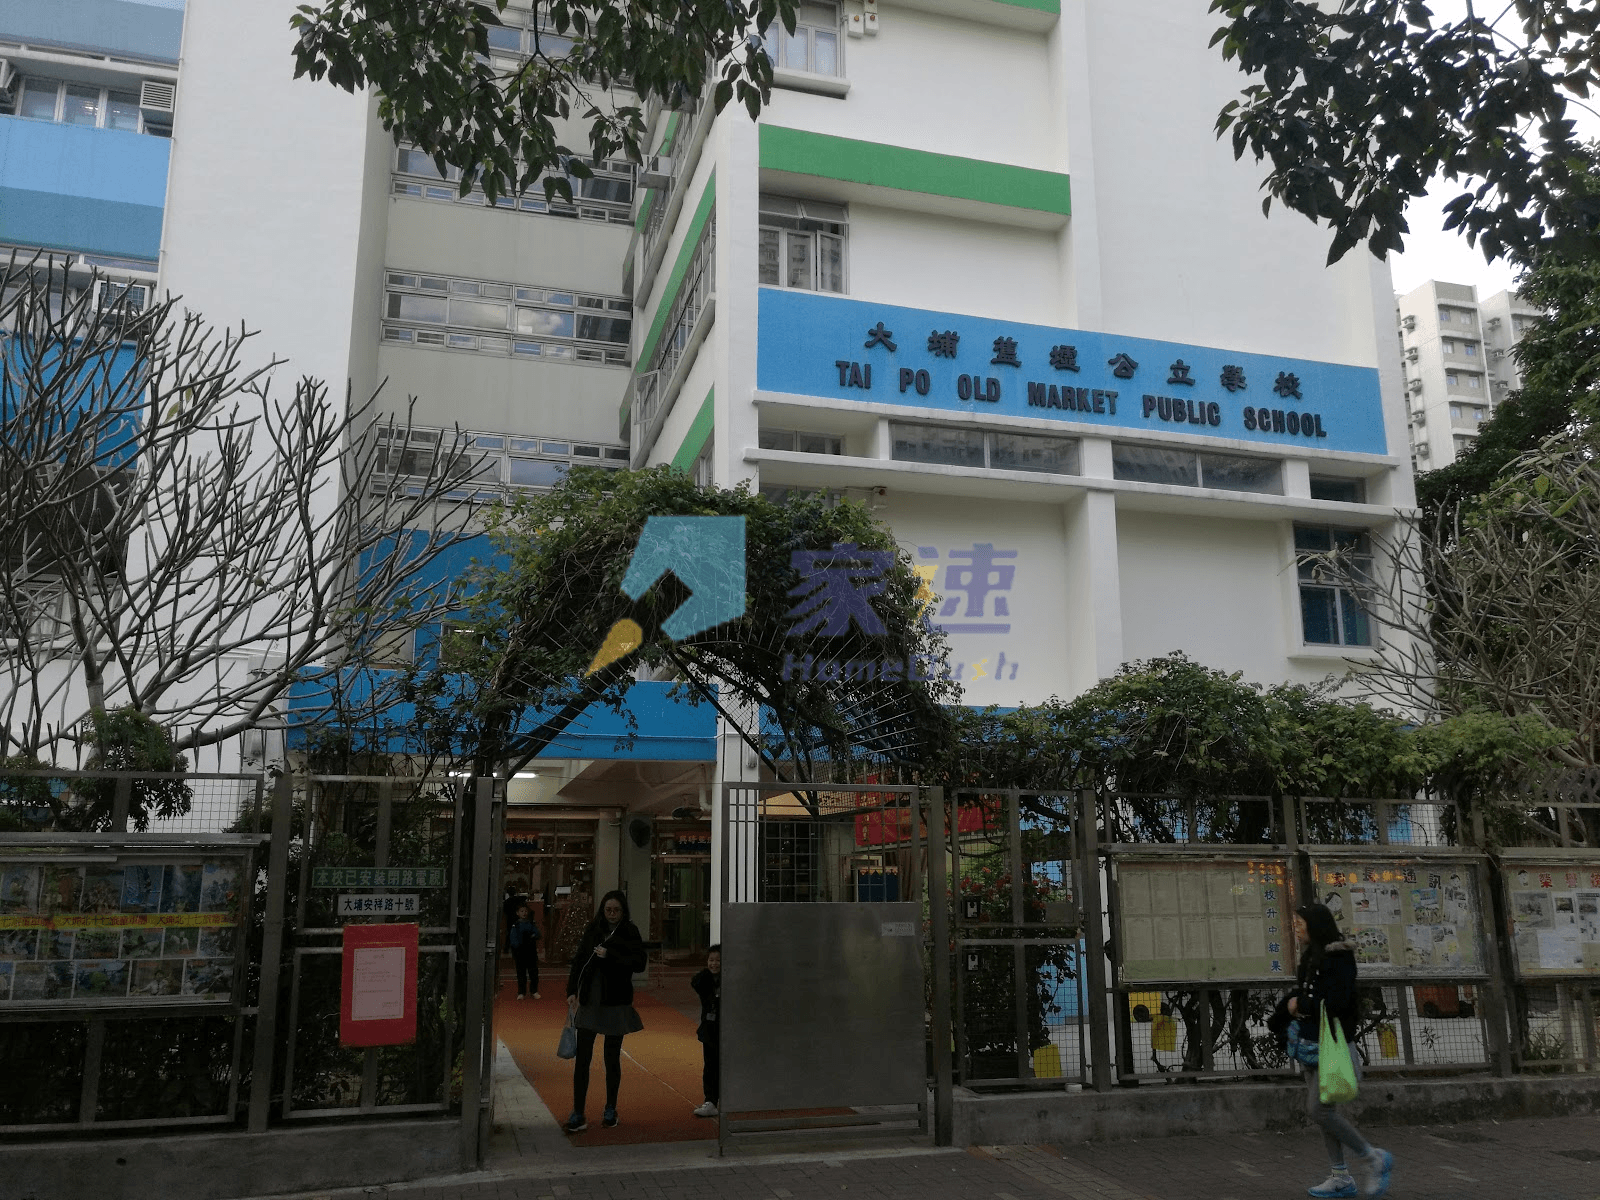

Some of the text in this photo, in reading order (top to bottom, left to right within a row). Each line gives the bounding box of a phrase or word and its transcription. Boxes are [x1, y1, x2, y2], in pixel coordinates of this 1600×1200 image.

[835, 361, 1328, 438] TAI PO OLD MARKET PUBLIC SCHOOL
[317, 869, 441, 886] 本校已安裝閉路電視
[344, 898, 415, 911] 大埔安祥路十號
[1263, 873, 1282, 972] 本校升中結果
